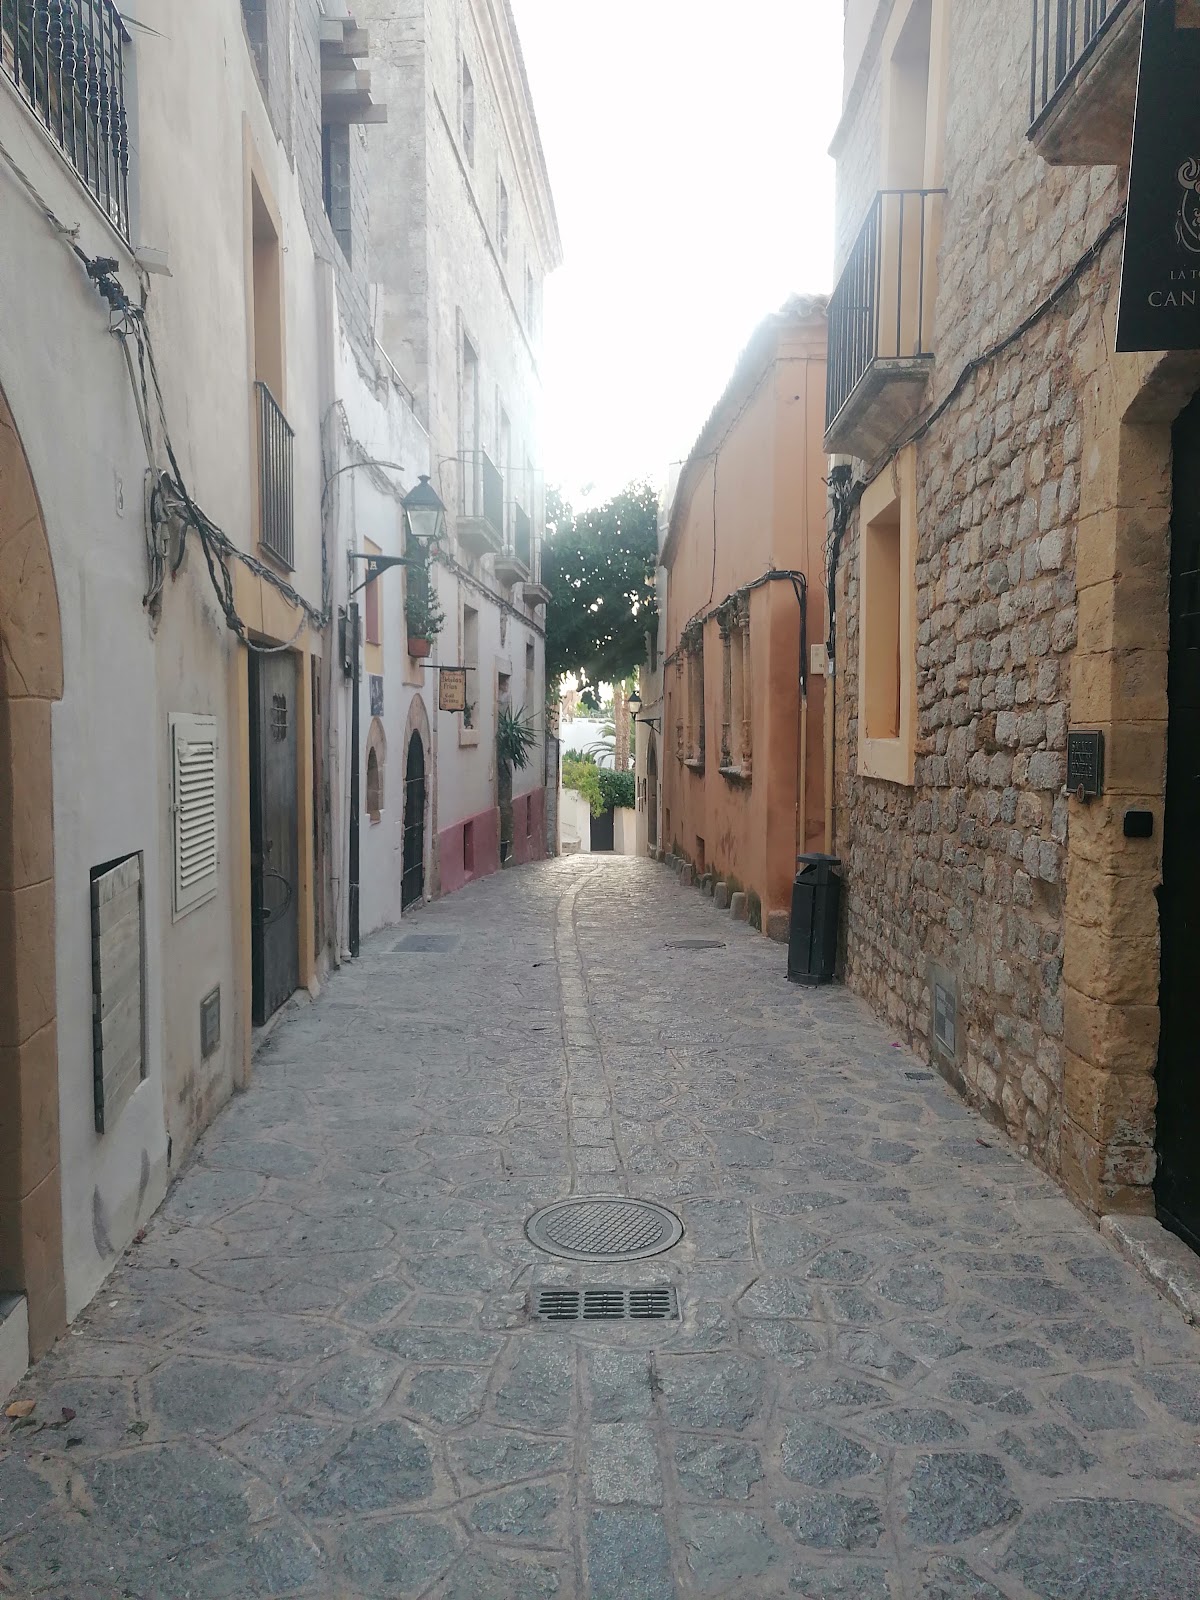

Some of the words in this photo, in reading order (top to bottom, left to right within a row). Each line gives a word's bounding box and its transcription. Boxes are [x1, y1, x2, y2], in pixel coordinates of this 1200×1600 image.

[1170, 270, 1186, 280] LA
[1190, 269, 1200, 279] T
[1147, 290, 1196, 307] CAN
